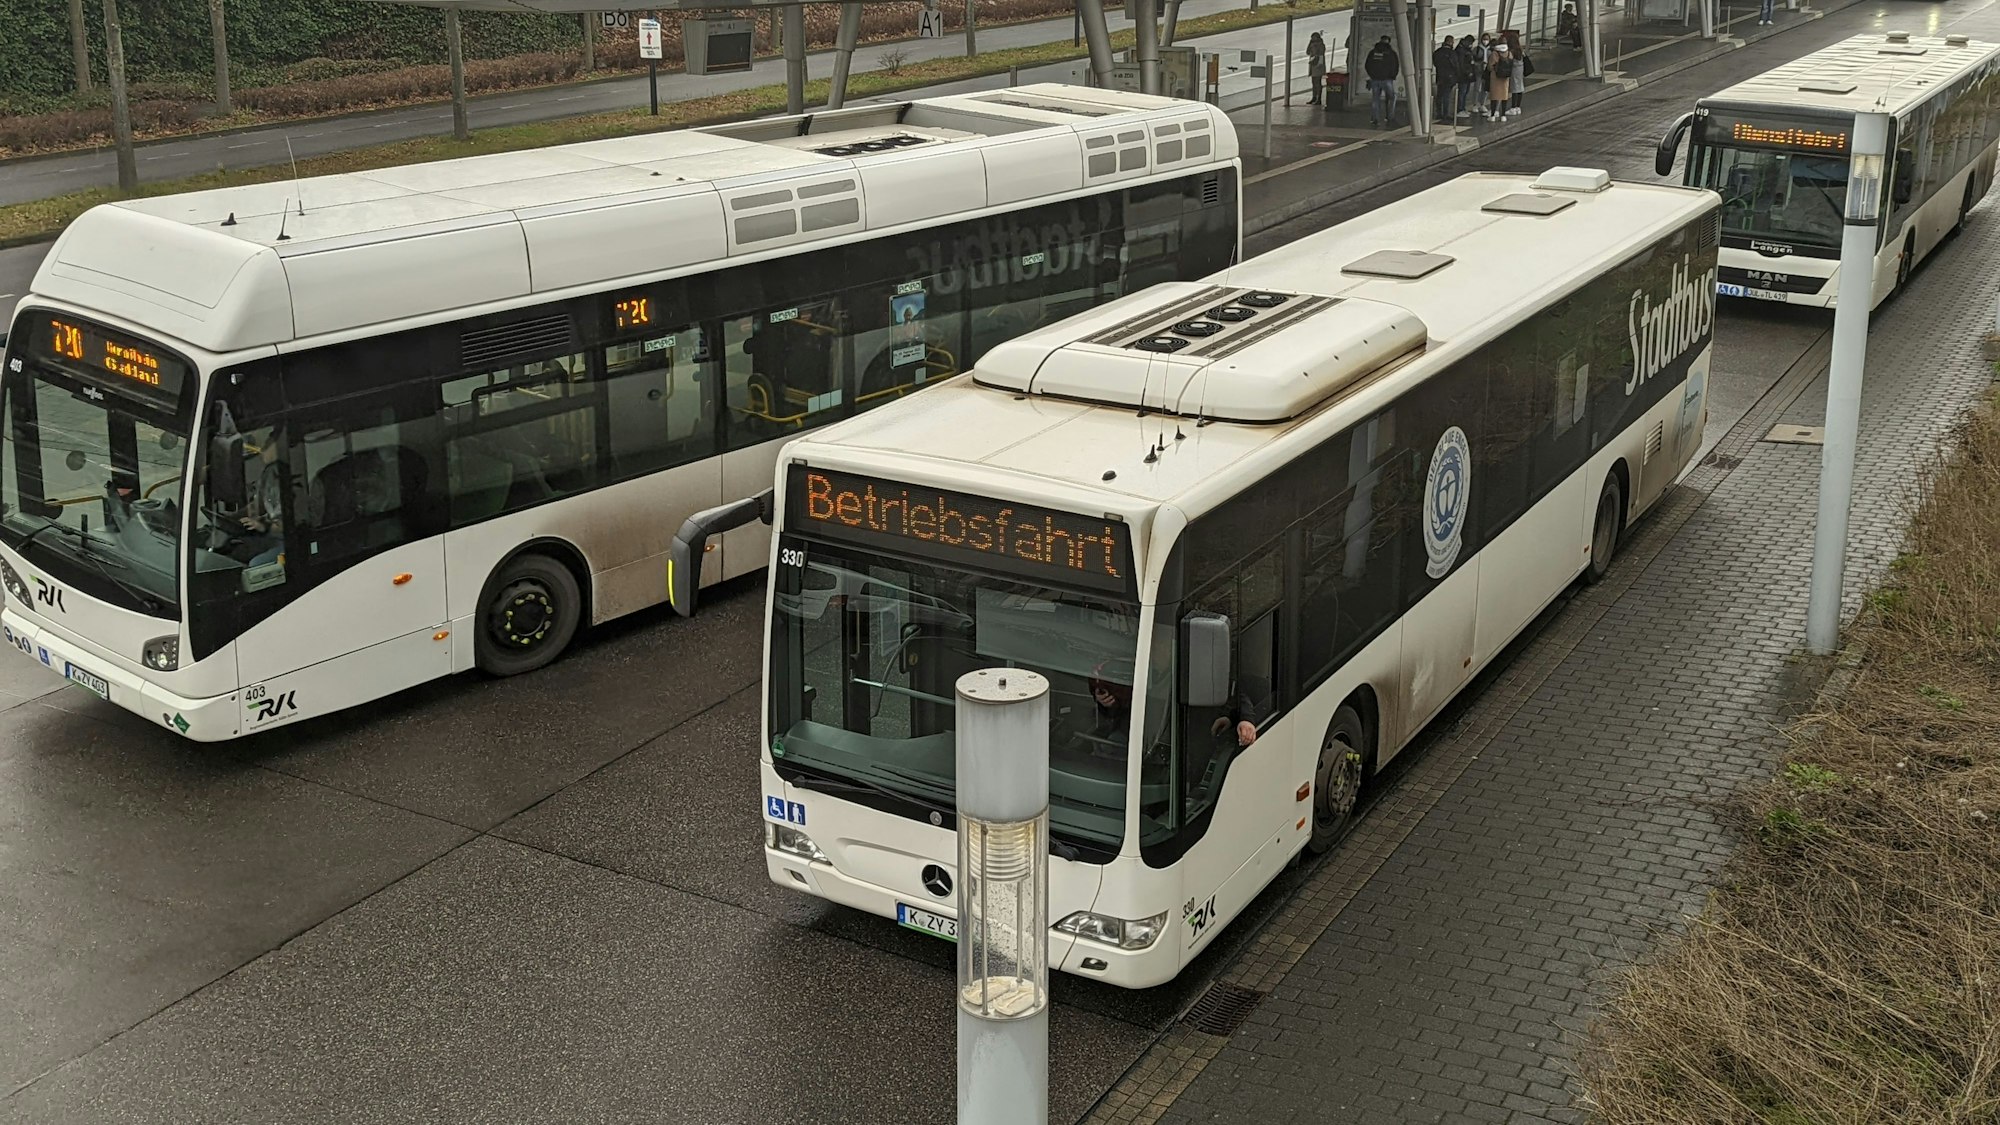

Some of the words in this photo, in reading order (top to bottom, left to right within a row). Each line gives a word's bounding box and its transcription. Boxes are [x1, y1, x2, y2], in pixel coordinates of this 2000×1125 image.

[920, 11, 941, 37] A1
[1750, 240, 1793, 254] Langen
[1747, 270, 1788, 283] MAN
[1625, 253, 1714, 396] Stadtbus
[9, 357, 23, 373] 403
[807, 472, 1122, 579] Betriebsfahrt
[781, 547, 804, 568] 330
[91, 678, 105, 694] 403
[245, 686, 266, 701] 403
[1182, 896, 1195, 919] 330
[910, 909, 918, 925] K
[927, 914, 944, 932] ZY
[947, 921, 958, 937] 3
